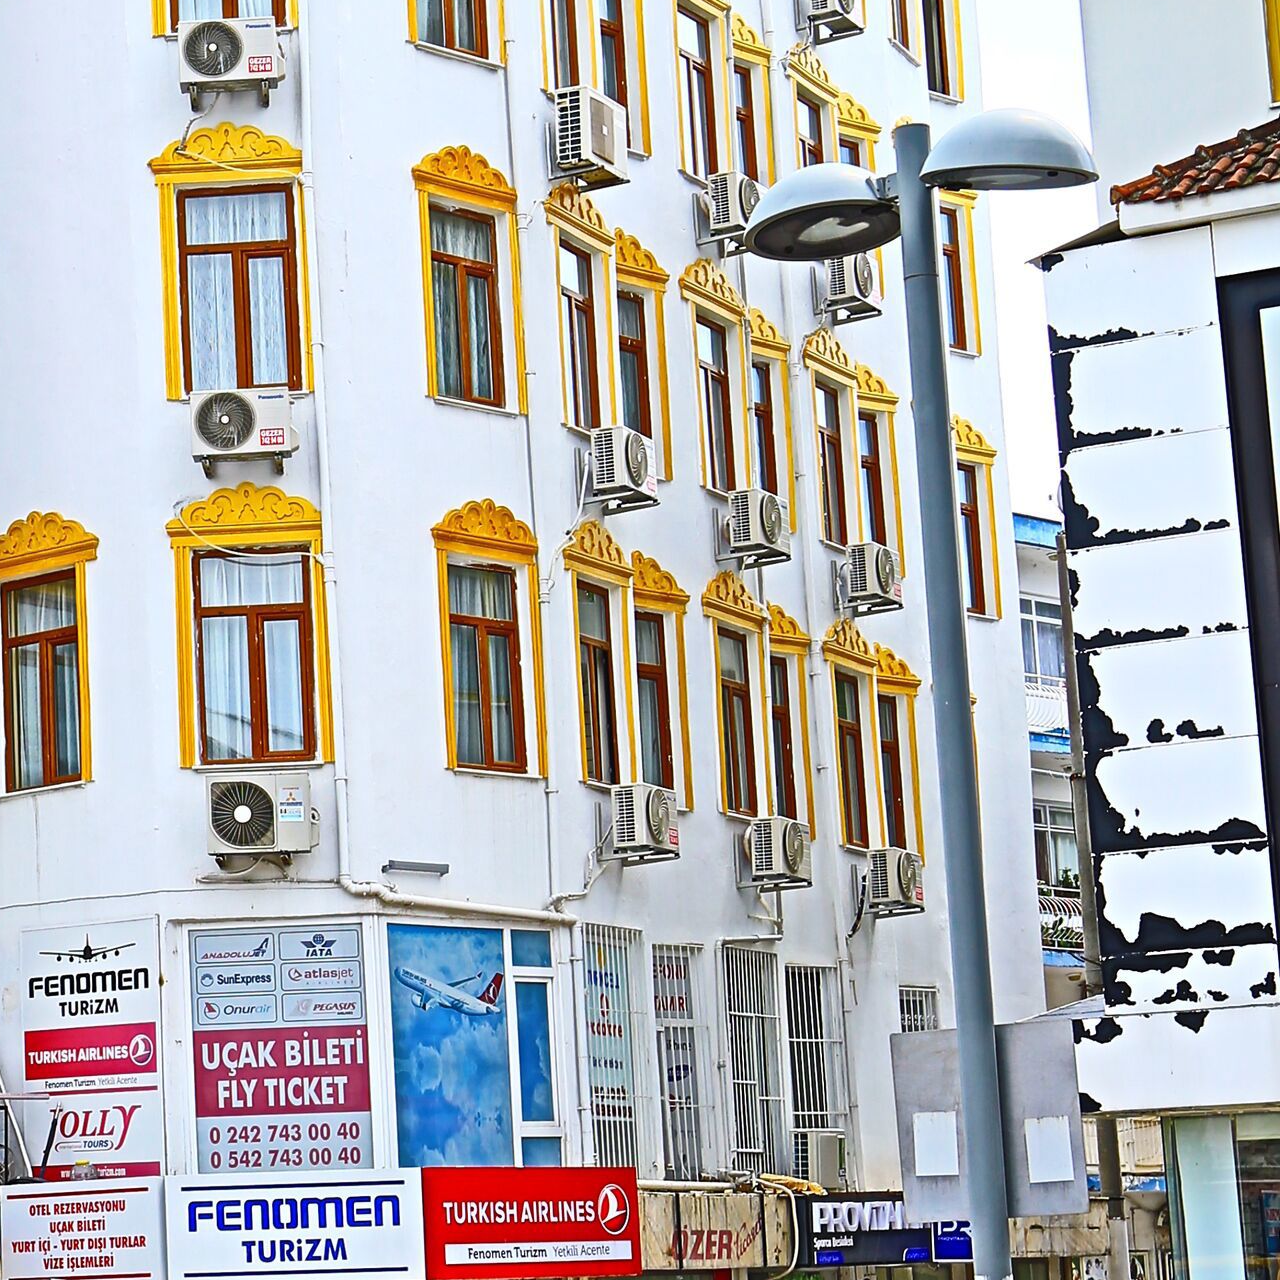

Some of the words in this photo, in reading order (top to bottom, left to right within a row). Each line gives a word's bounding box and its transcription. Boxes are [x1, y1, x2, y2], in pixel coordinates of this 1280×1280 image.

[305, 948, 332, 957] IATA
[28, 967, 150, 998] FENOMEN
[217, 973, 271, 986] SunExpress
[304, 968, 354, 981] atlasjet
[313, 1001, 357, 1012] PEGASUS
[28, 1048, 76, 1064] TURKISH
[78, 1045, 129, 1061] AIRLINES
[201, 1040, 277, 1077] UÇAK
[284, 1029, 363, 1067] BİLETİ
[217, 1079, 258, 1109] FLY
[263, 1076, 348, 1107] TICKET
[209, 1127, 221, 1144] 0
[226, 1125, 261, 1144] 242
[267, 1124, 302, 1142] 743
[308, 1123, 331, 1141] 00
[337, 1122, 360, 1140] 40
[83, 1140, 109, 1149] TOURS
[210, 1151, 221, 1169] 0
[228, 1150, 262, 1168] 542
[268, 1149, 303, 1166] 743
[309, 1148, 332, 1166] 00
[338, 1147, 361, 1165] 40
[29, 1204, 51, 1217] OTEL
[53, 1200, 126, 1215] REZERVASYONU
[188, 1195, 400, 1232] FENOMEN
[443, 1201, 518, 1224] TURKISH
[521, 1200, 596, 1223] AIRLINES
[49, 1221, 74, 1236] UÇAK
[77, 1215, 106, 1231] BİLETİ
[12, 1240, 36, 1253] YURT
[60, 1238, 85, 1251] YURT
[88, 1237, 106, 1253] DIŞI
[109, 1235, 146, 1249] TURLAR
[468, 1247, 513, 1260] Fenomen
[513, 1246, 548, 1258] Turizm
[552, 1245, 578, 1257] Yetkili
[580, 1244, 610, 1256] Acente
[671, 1224, 732, 1261] ÖZER
[43, 1255, 64, 1270] VİZE
[66, 1252, 114, 1272] İŞLEMLERİ
